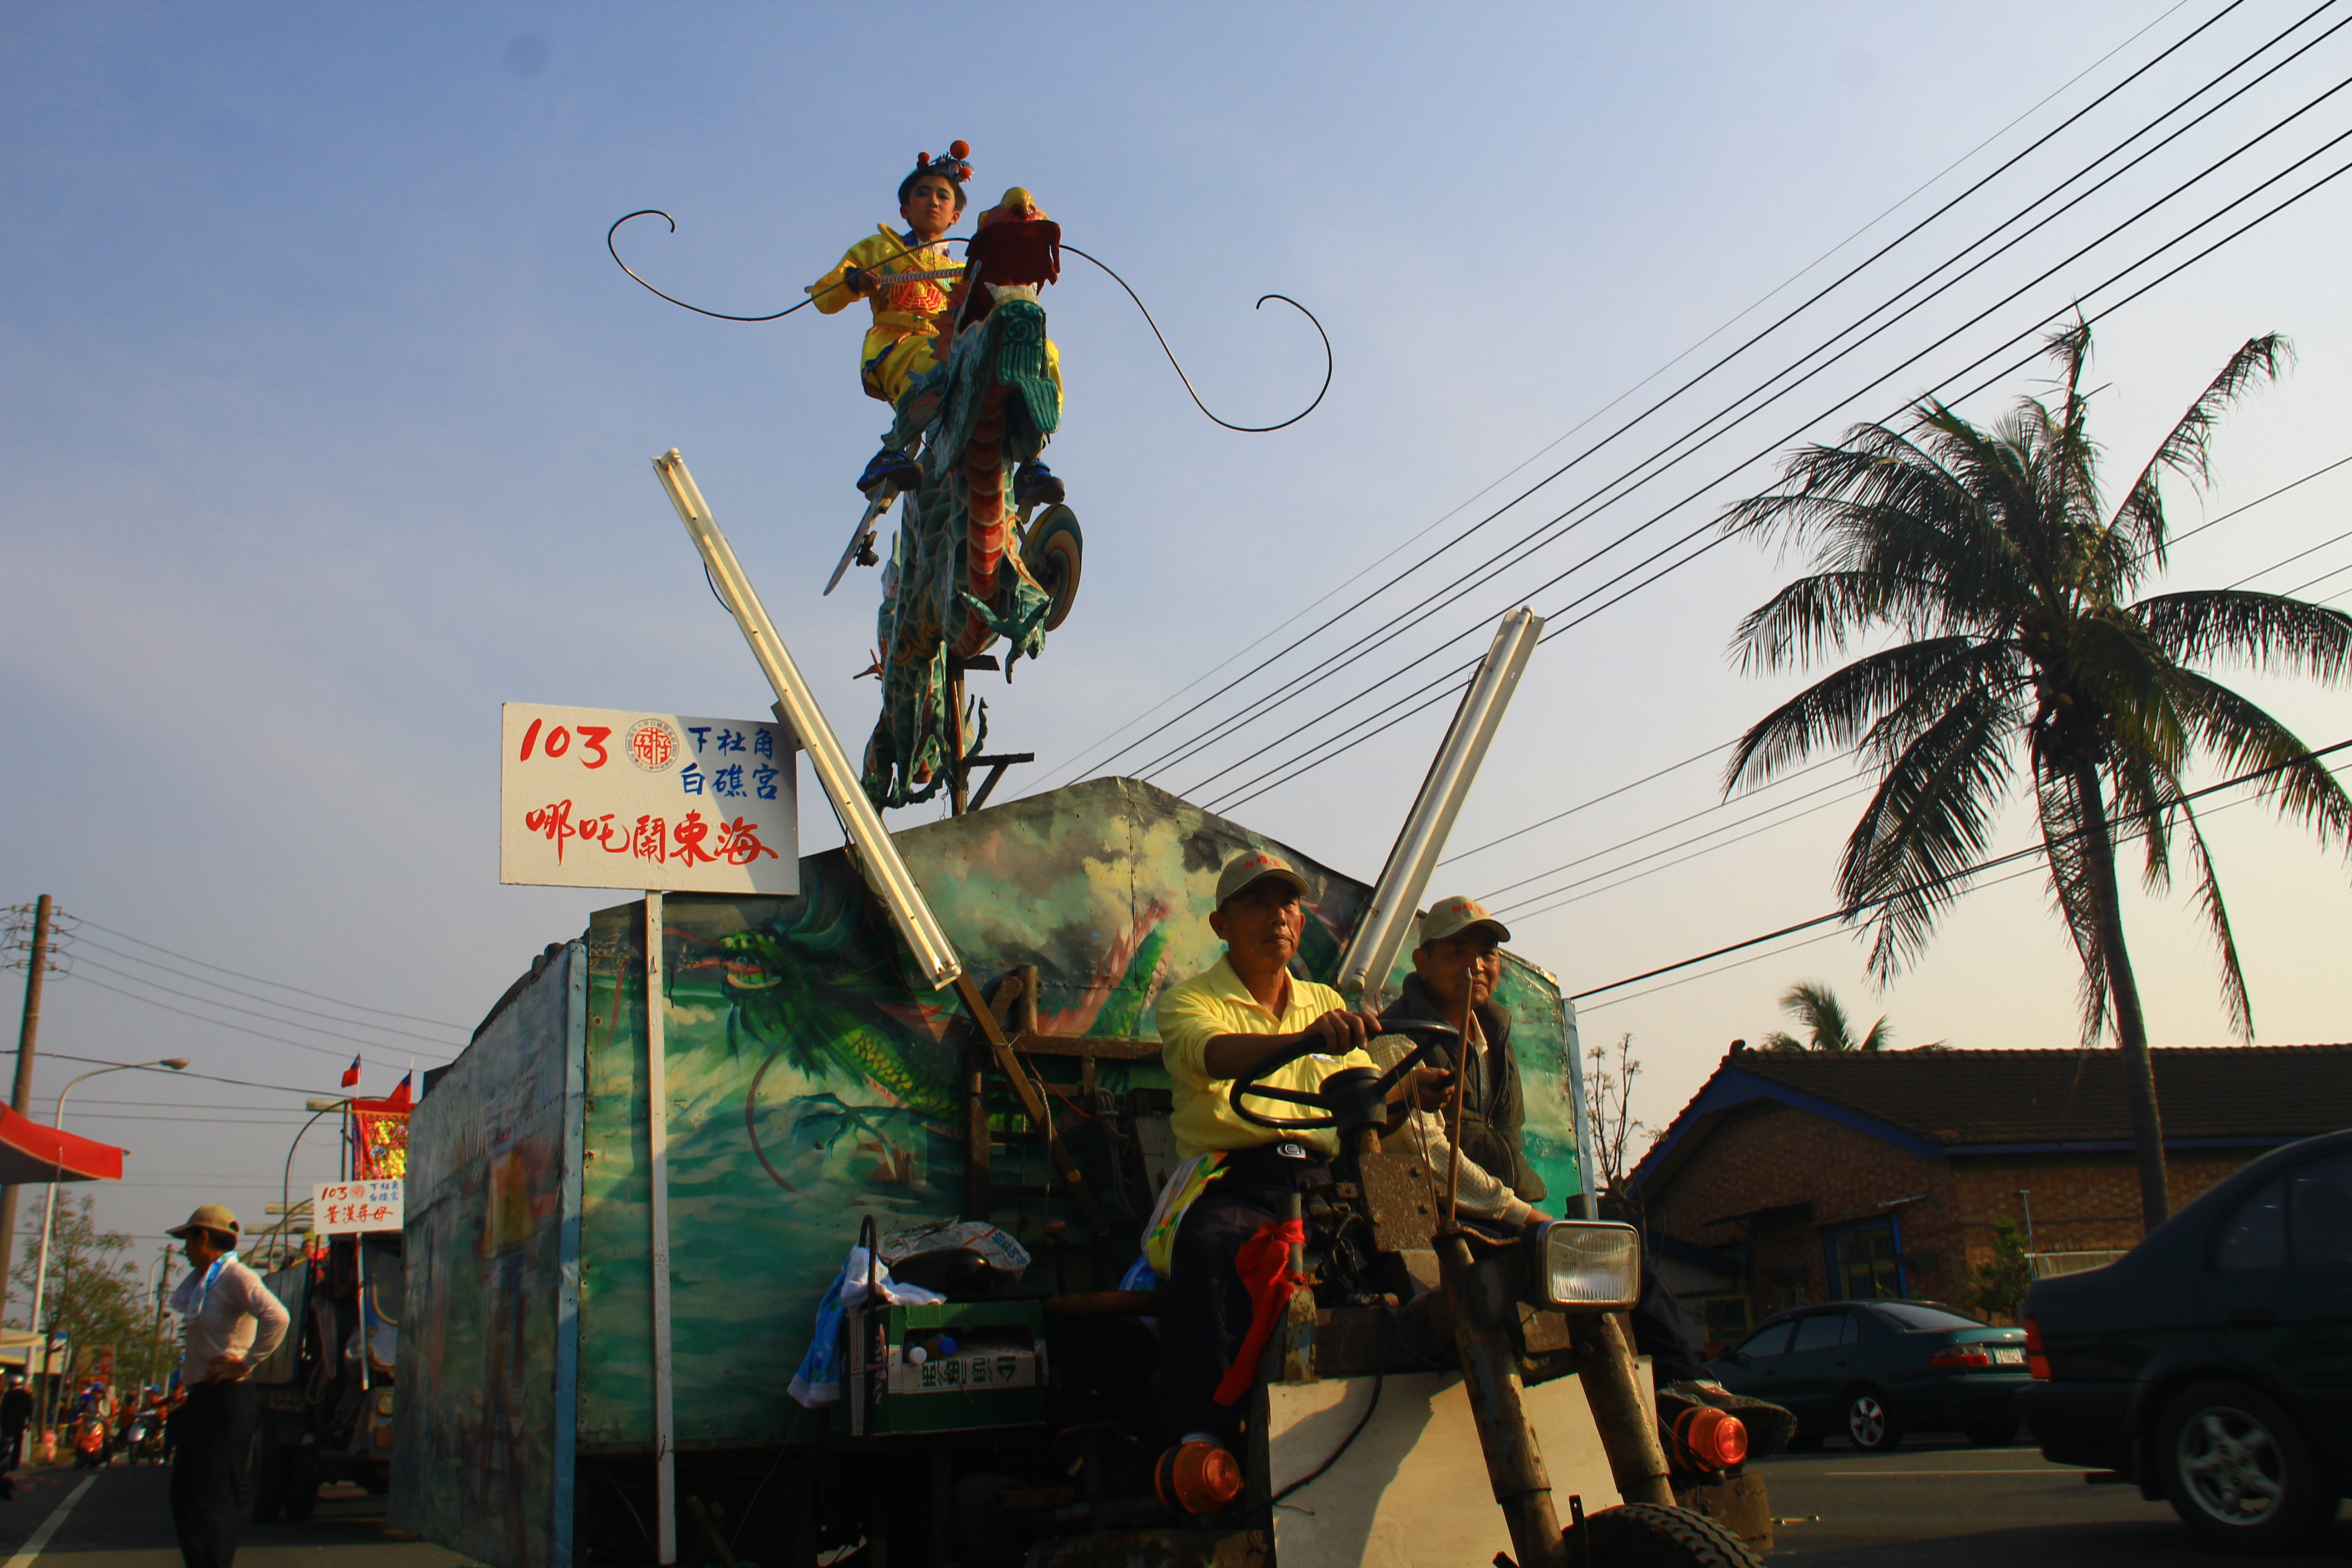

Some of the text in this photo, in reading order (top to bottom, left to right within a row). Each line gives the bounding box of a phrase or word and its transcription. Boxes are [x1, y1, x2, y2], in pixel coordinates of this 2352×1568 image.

[519, 717, 613, 770] 103
[686, 726, 774, 760] 下社角
[680, 762, 780, 800] 白礁宮
[321, 1186, 348, 1201] 103
